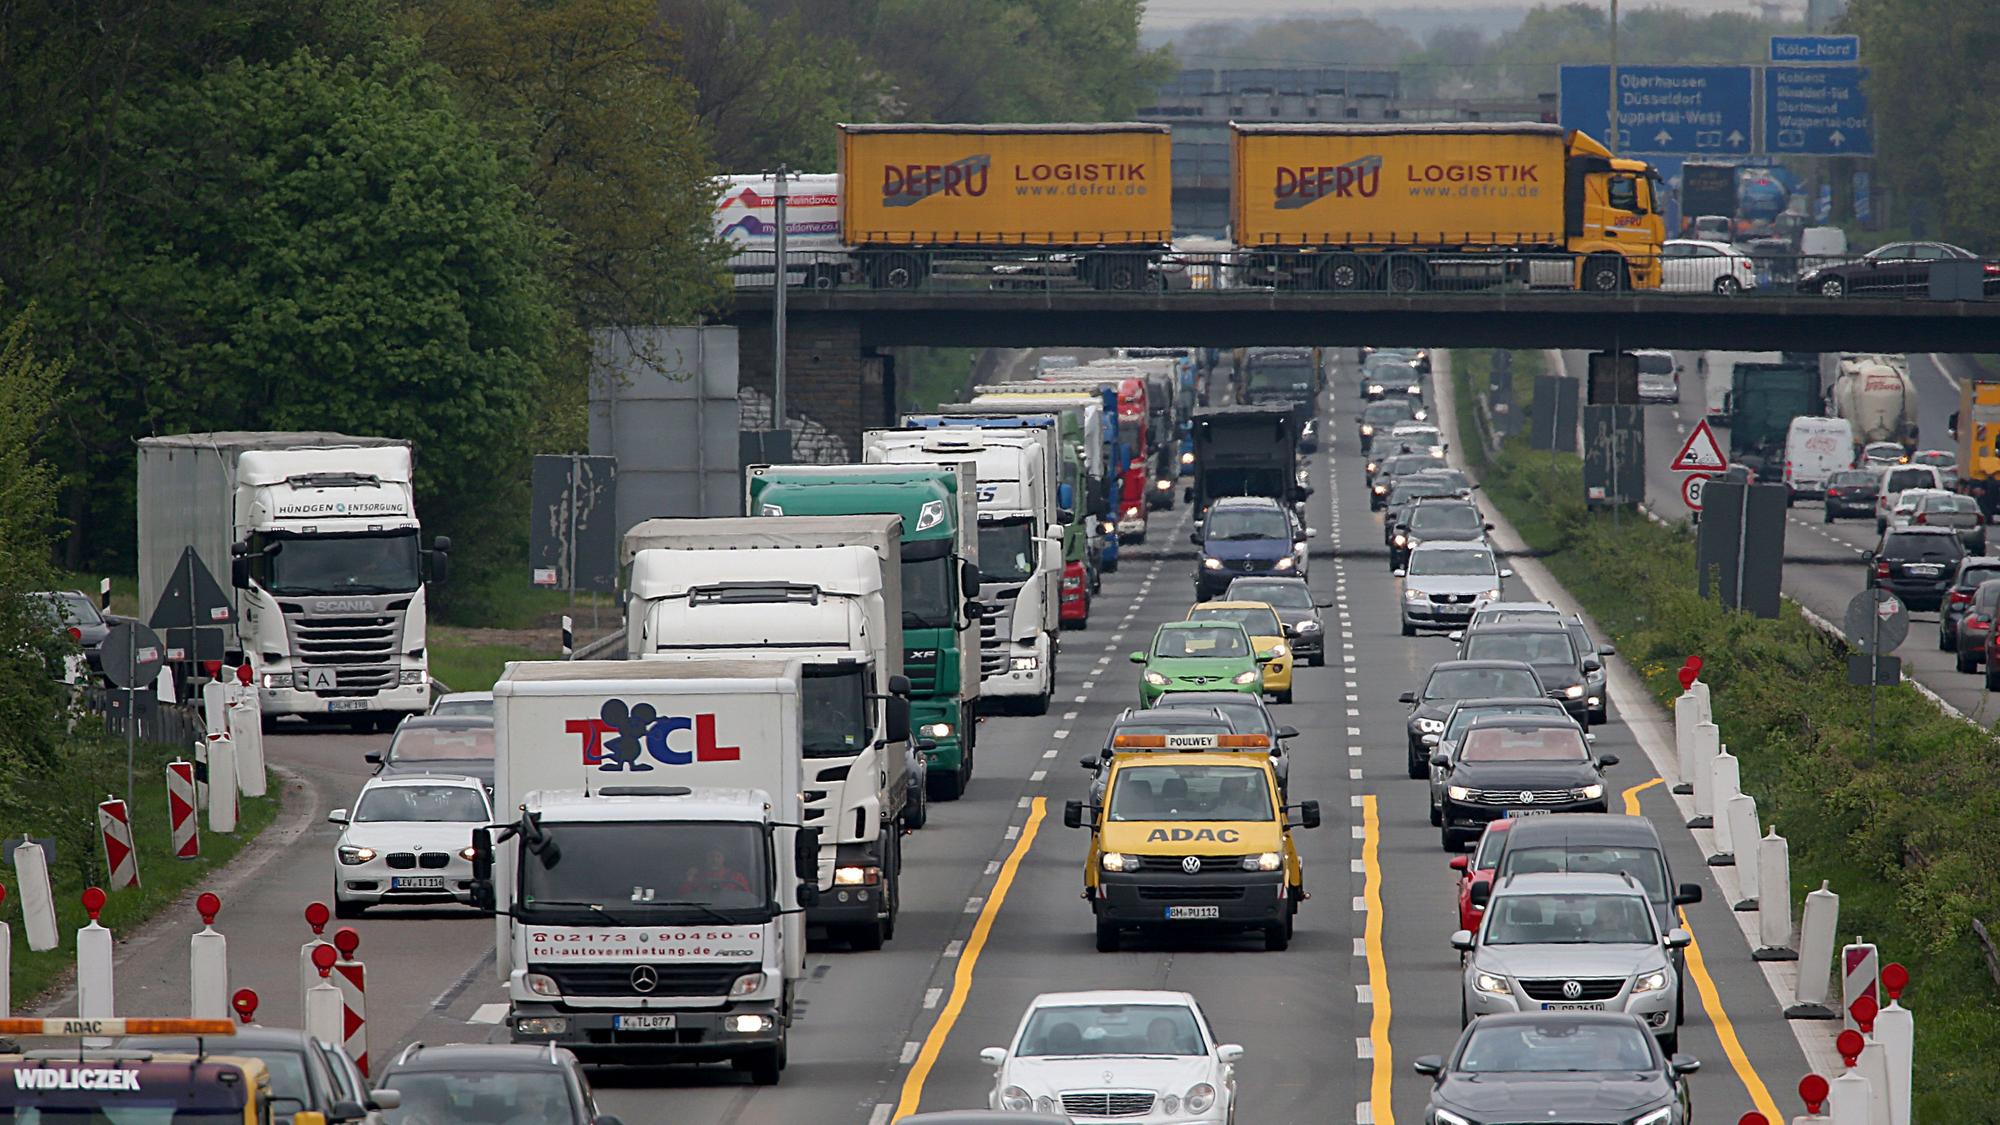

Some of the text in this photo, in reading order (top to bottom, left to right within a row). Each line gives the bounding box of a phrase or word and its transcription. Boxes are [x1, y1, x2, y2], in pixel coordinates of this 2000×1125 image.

[1777, 43, 1850, 56] Köln-Nord
[1620, 74, 1706, 88] Oberhausen
[1777, 72, 1825, 83] Koblenz
[1623, 92, 1702, 105] Düsseldorf
[1777, 102, 1838, 113] Dortmund
[1015, 163, 1146, 181] LOGISTIK
[1407, 164, 1538, 182] LOGISTIK
[884, 165, 988, 197] DEFRU
[1276, 166, 1380, 198] DEFRU
[1016, 182, 1147, 196] www.defru.de
[1408, 184, 1540, 198] www.defru.de
[279, 503, 403, 513] HÜNDGEN ENTSORGUNG
[315, 600, 375, 612] SCANIA
[910, 650, 936, 659] XF
[315, 672, 330, 687] A
[1169, 737, 1213, 747] POULWEY
[1147, 828, 1240, 843] ADAC
[554, 933, 627, 943] 02173
[534, 947, 711, 957] tcl-autovermietung.de
[63, 1021, 103, 1034] ADAC
[14, 1068, 141, 1091] WIDLICZEK
